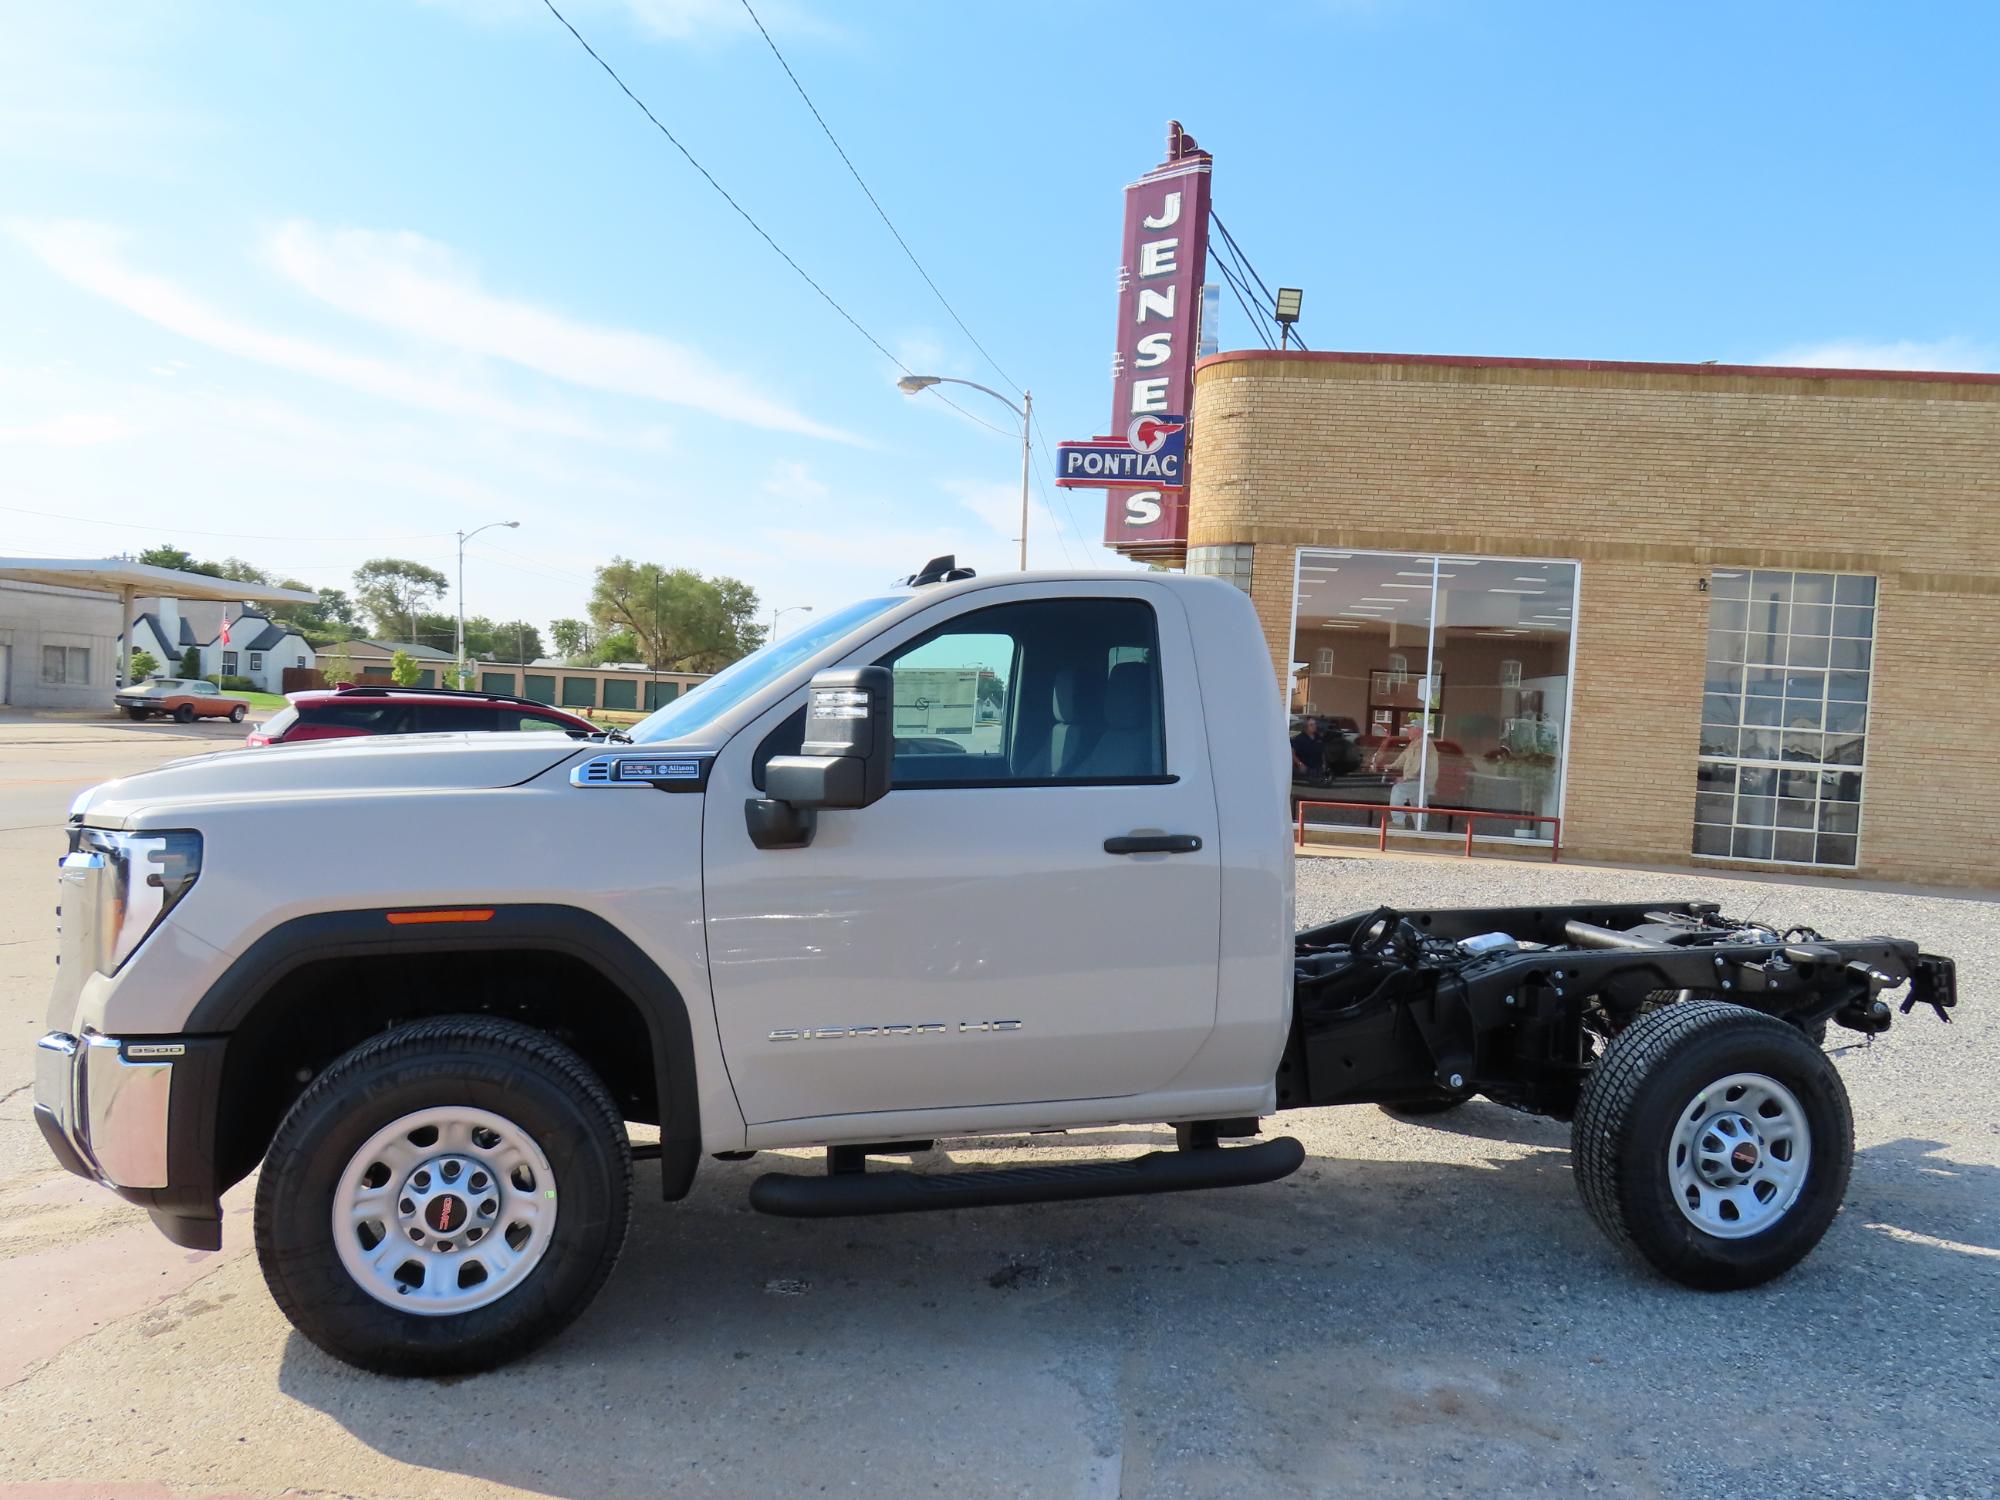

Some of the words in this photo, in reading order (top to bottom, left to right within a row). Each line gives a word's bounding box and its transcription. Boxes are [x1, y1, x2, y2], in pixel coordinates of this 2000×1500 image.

[1123, 192, 1182, 525] JENSES
[1067, 452, 1178, 476] PONTIAC
[768, 1026, 945, 1040] SIERRA
[439, 1197, 453, 1230] GMC
